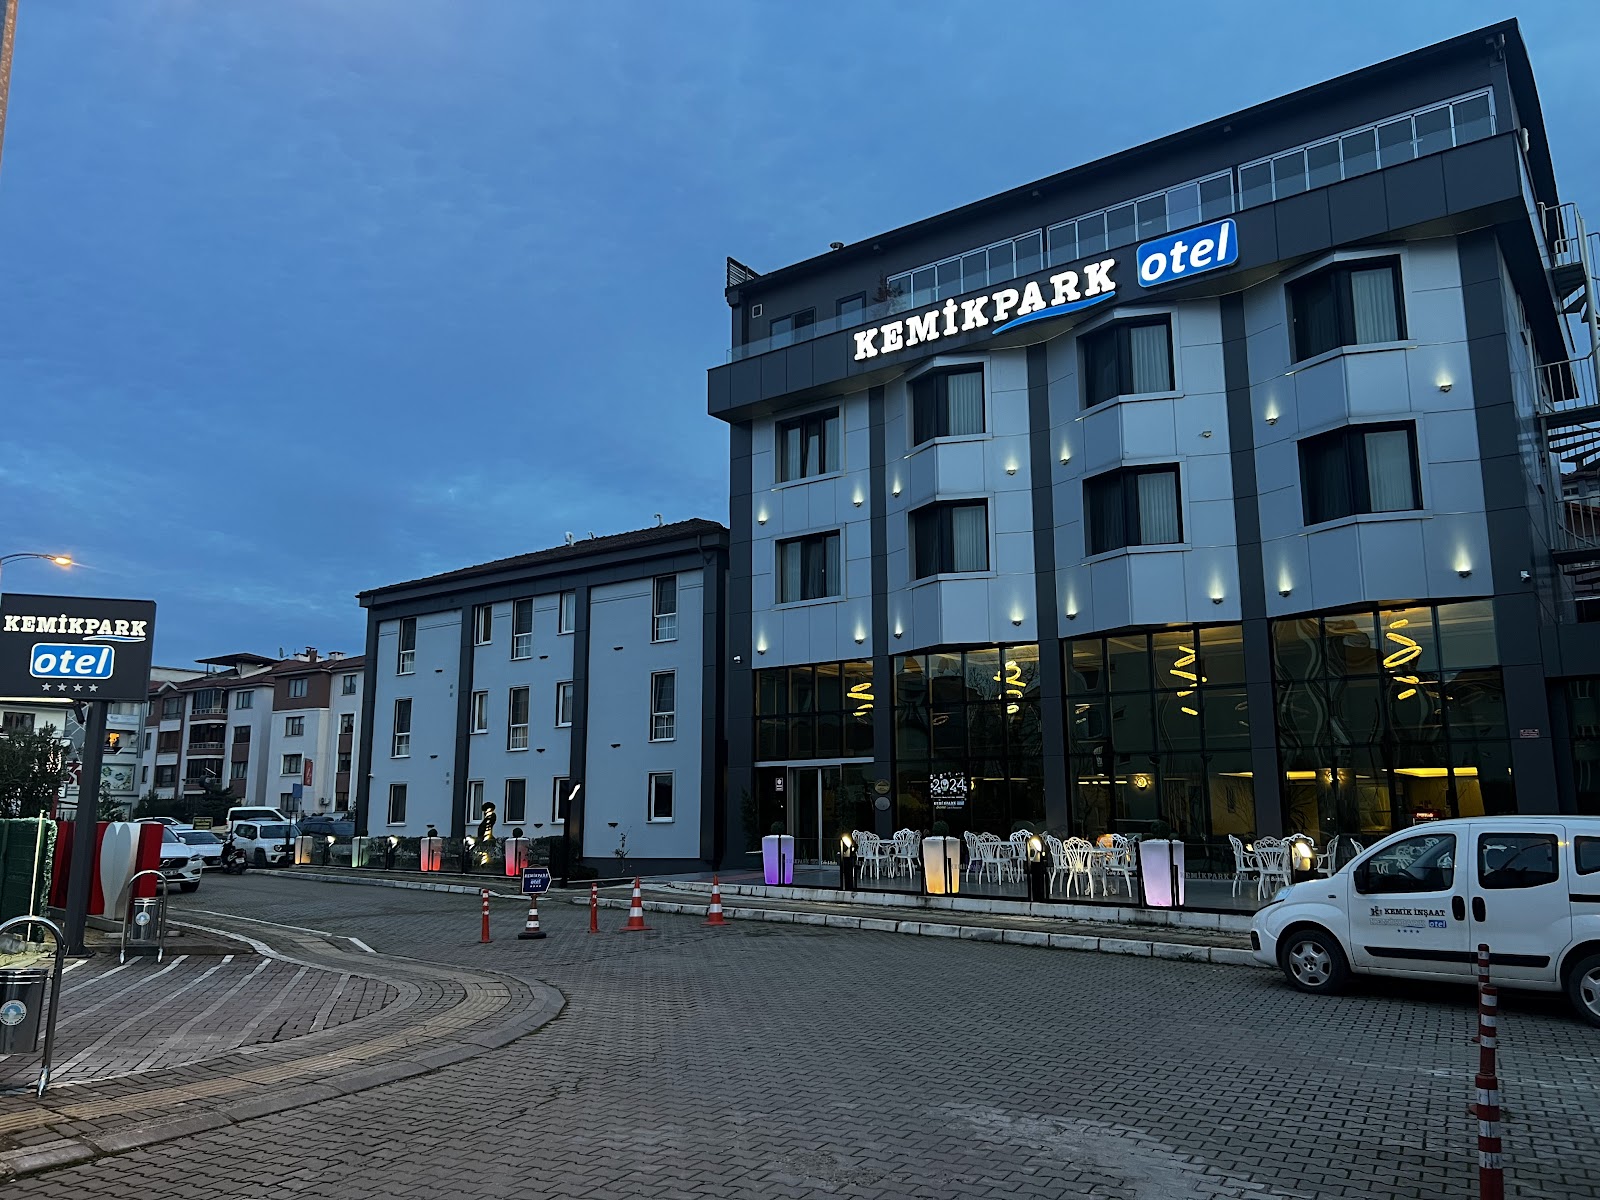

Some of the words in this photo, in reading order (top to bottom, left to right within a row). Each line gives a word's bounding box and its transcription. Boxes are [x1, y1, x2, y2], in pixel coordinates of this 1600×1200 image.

[853, 258, 1116, 361] KEMİKPARK
[1140, 222, 1231, 281] otel
[3, 613, 147, 636] KEMİKPARK
[34, 648, 110, 674] otel
[933, 778, 964, 791] 2024
[1384, 907, 1412, 915] KEMİK
[1414, 907, 1446, 917] İNŞAAT
[1429, 920, 1446, 928] otel
